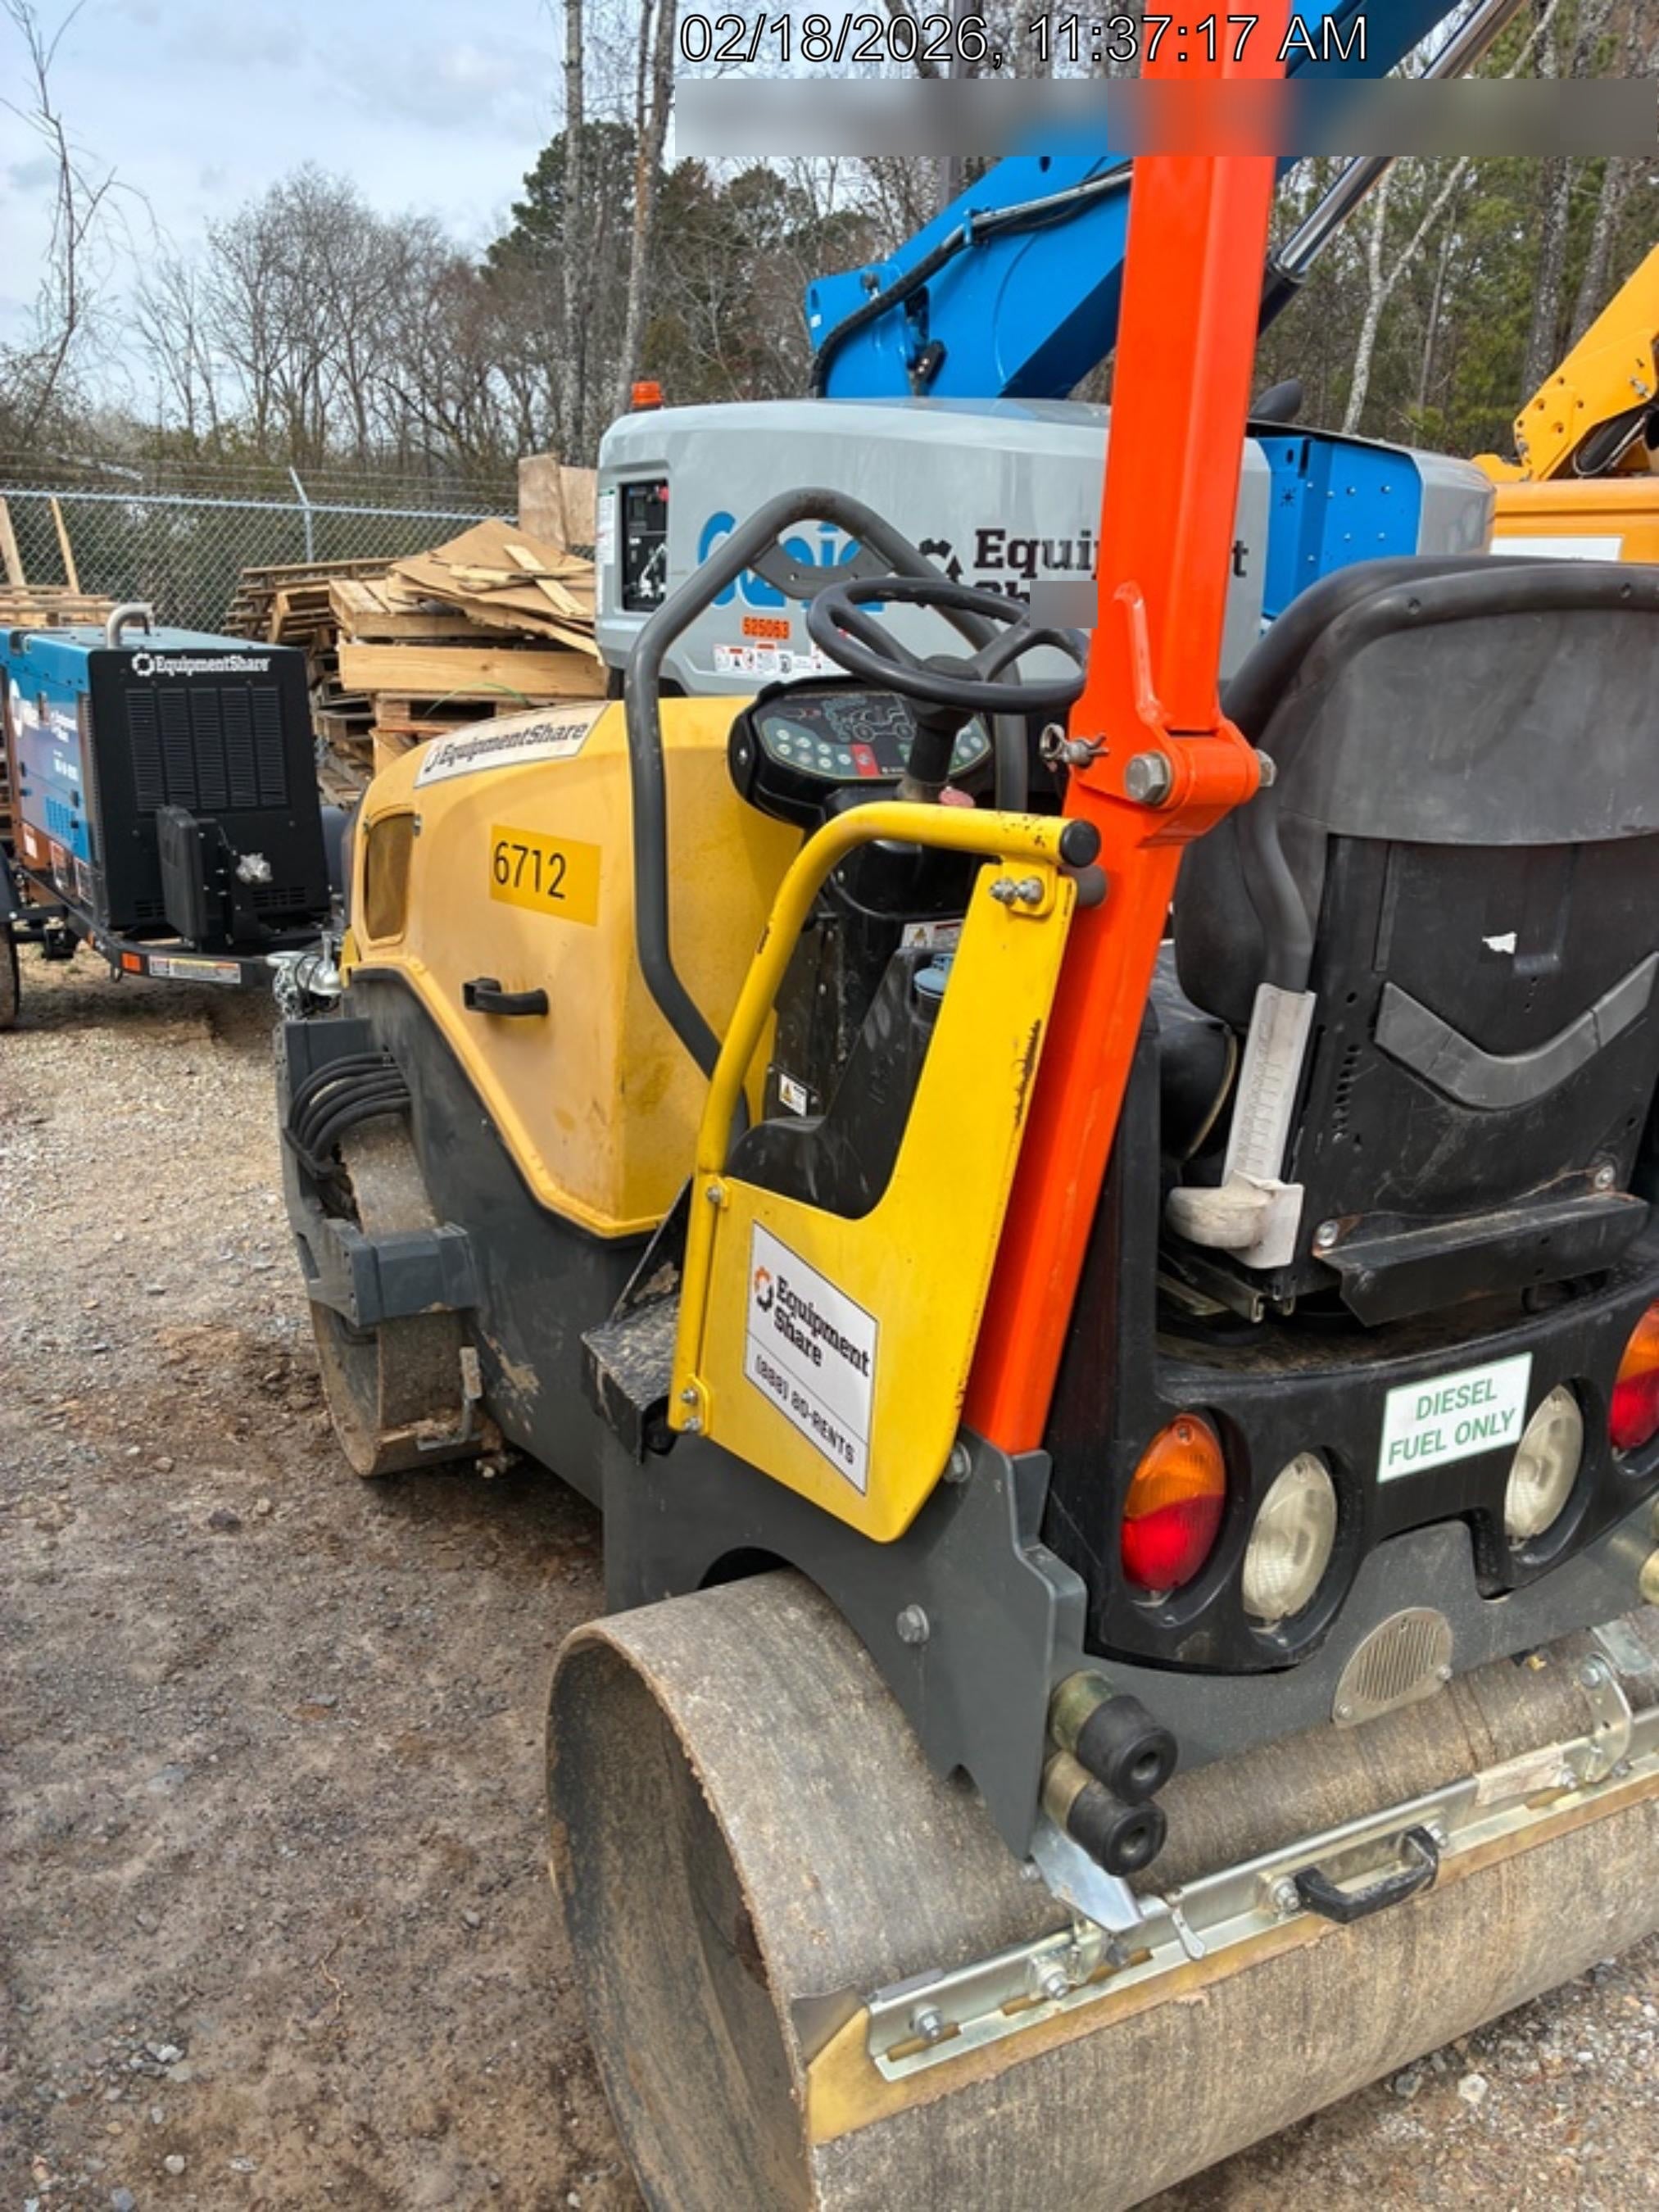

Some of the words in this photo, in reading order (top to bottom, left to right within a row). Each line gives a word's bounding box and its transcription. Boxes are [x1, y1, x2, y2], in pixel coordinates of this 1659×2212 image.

[972, 528, 1249, 580] Equit
[438, 722, 589, 767] EquipmentShare
[493, 841, 567, 900] 6712
[773, 1308, 823, 1367] Share
[775, 1274, 870, 1377] Equipment
[1415, 1378, 1498, 1421] DIESEL
[1388, 1428, 1447, 1466] FUEL
[1453, 1407, 1516, 1446] ONLY
